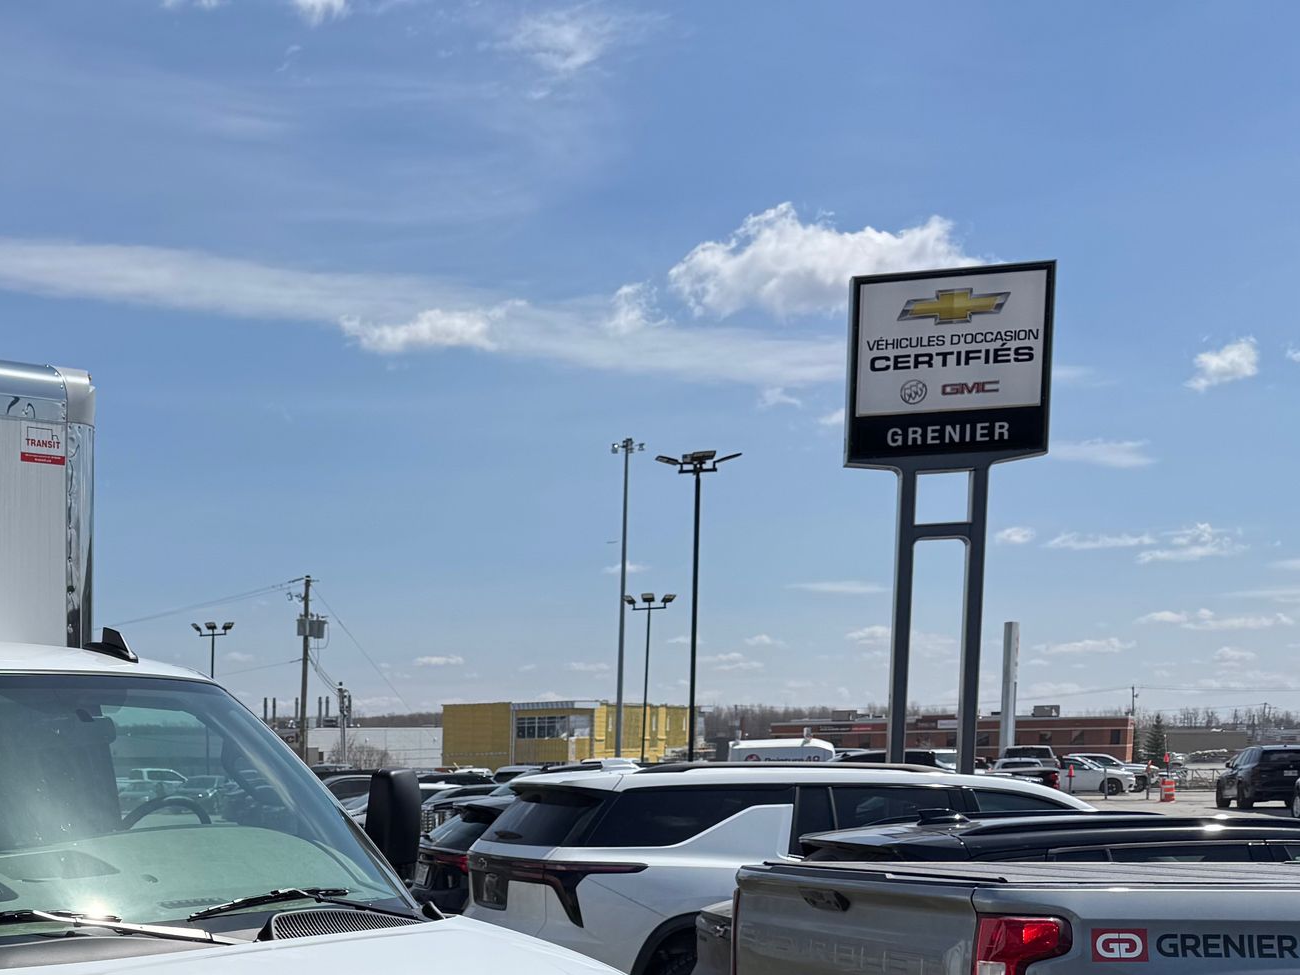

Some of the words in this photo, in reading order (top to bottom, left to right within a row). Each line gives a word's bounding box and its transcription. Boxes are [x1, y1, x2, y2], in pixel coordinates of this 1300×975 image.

[866, 335, 946, 352] VÉHICULES
[950, 328, 1040, 346] D'OCCASION
[869, 342, 1035, 372] CERTIFIÉS
[941, 380, 1000, 396] GMC
[25, 438, 61, 450] TRANSIT
[886, 421, 1010, 447] GRENIER
[1155, 933, 1300, 959] GRENIER
